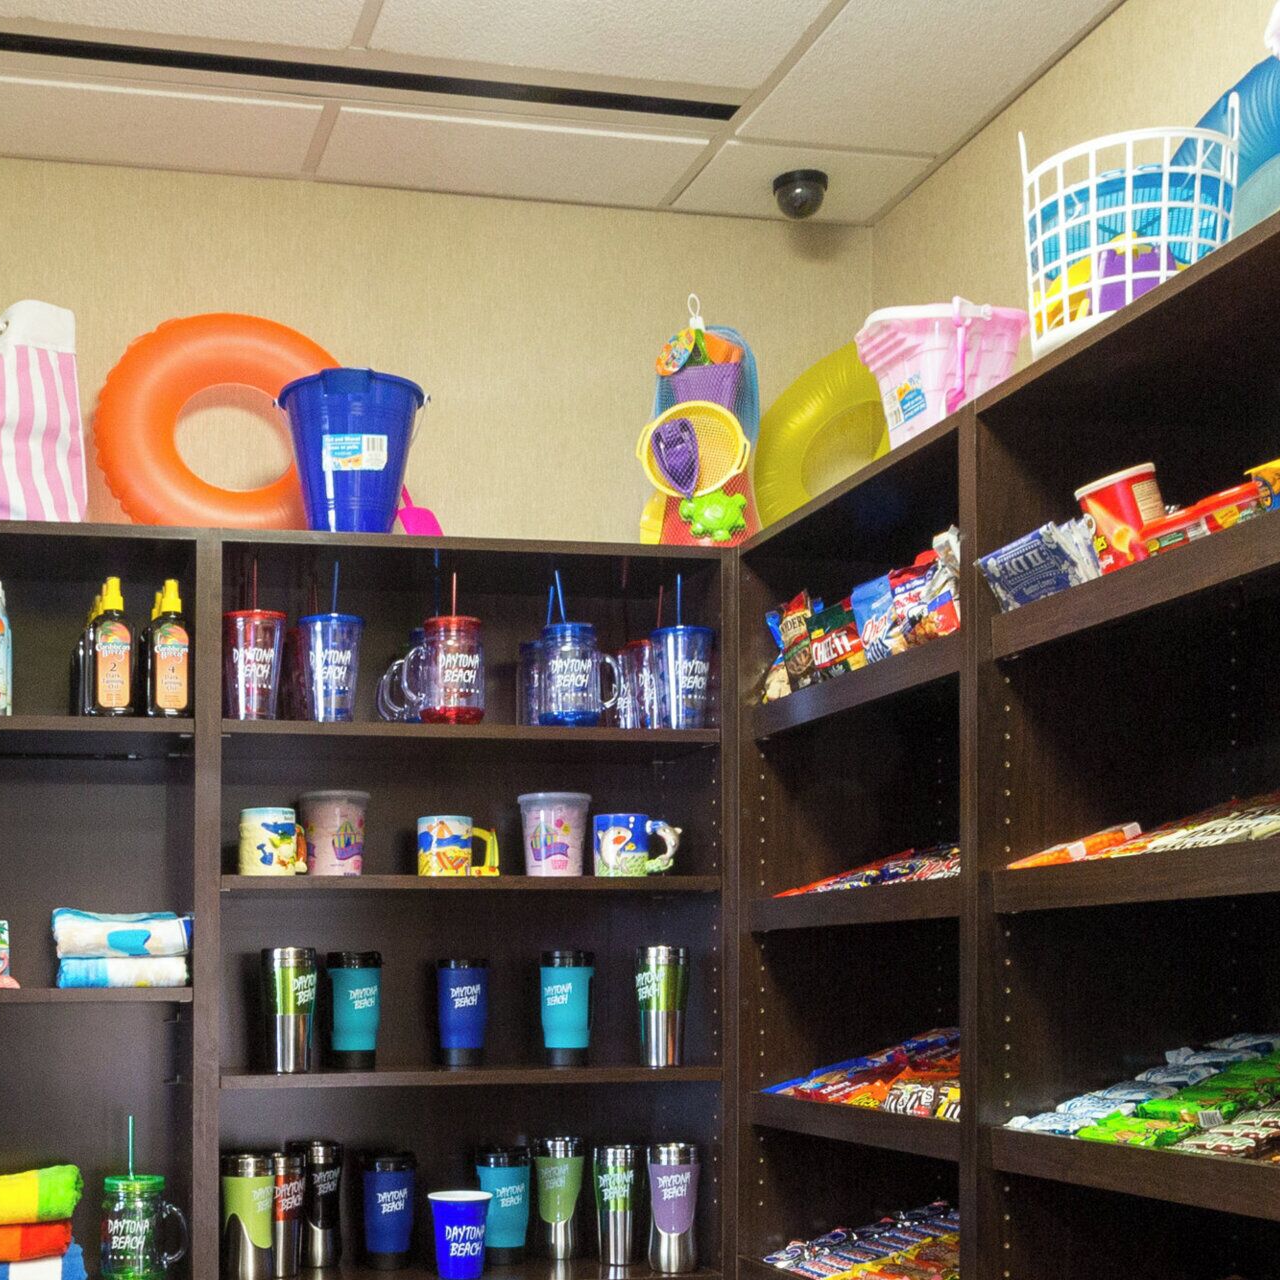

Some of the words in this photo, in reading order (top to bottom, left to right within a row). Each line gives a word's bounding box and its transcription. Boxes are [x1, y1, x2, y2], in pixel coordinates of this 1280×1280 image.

[439, 653, 480, 670] DAYTONA
[551, 658, 592, 675] DAYTONA
[444, 670, 476, 684] BEACH
[556, 673, 589, 688] BEACH
[450, 984, 481, 1000] DAYTONA
[454, 996, 478, 1008] BEACH
[598, 1169, 634, 1189] DAYTONA
[656, 1172, 692, 1189] DAYTONA
[376, 1187, 408, 1204] DAYTONA
[496, 1183, 525, 1199] DAYTONA
[602, 1184, 631, 1202] BEACH
[661, 1185, 688, 1201] BEACH
[381, 1200, 405, 1214] BEACH
[500, 1194, 523, 1208] BEACH
[108, 1219, 150, 1236] DAYTONA
[444, 1225, 486, 1242] DAYTONA
[111, 1234, 145, 1250] BEACH
[449, 1240, 482, 1258] BEACH
